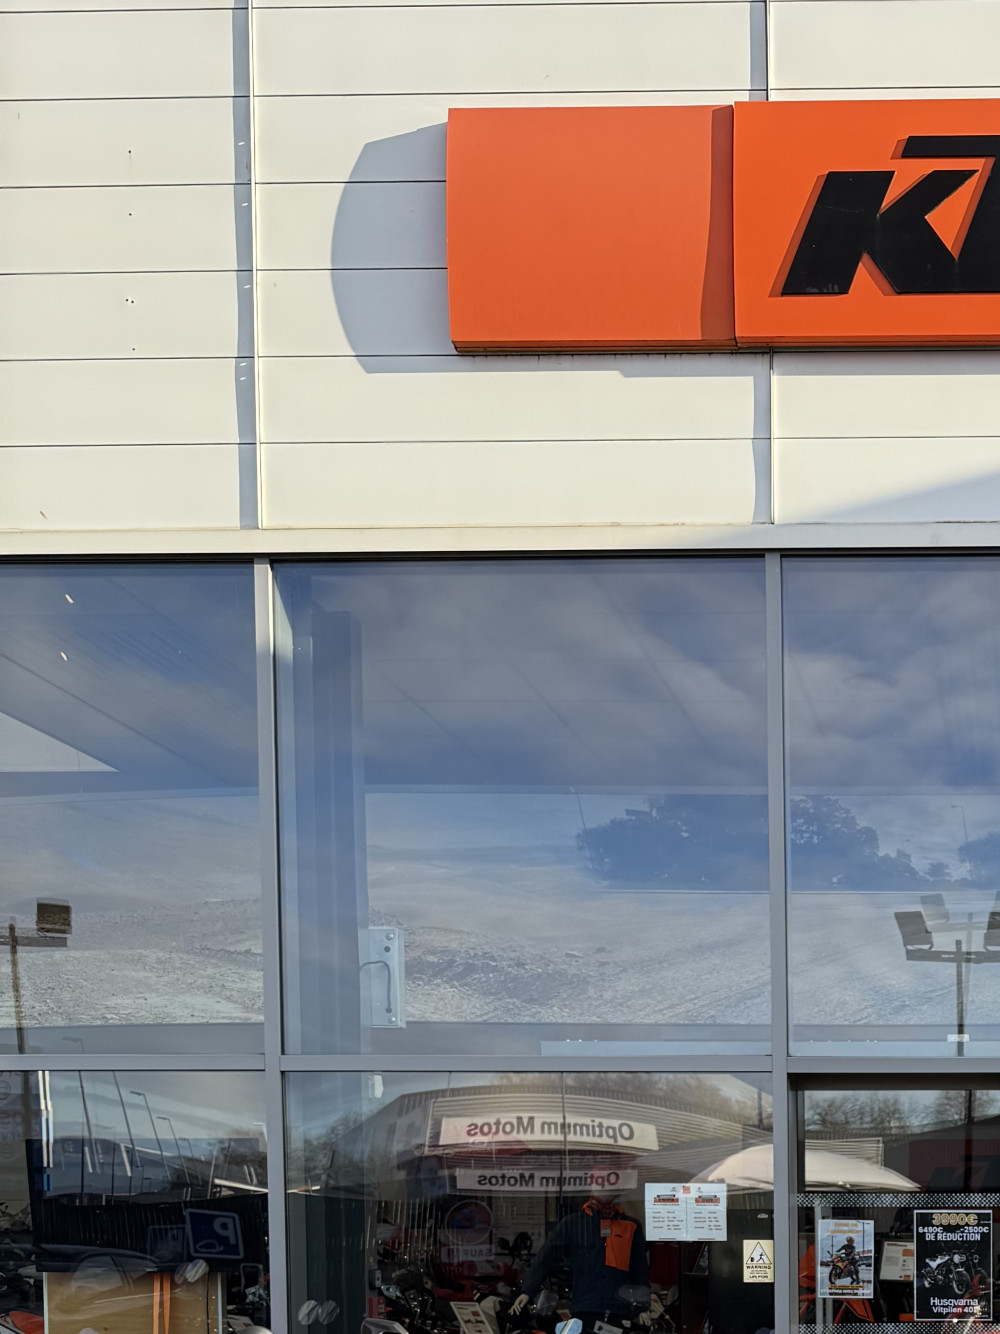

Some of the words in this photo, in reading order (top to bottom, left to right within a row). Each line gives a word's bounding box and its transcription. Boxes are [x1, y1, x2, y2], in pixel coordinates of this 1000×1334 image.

[932, 1213, 978, 1225] 3990€
[937, 1231, 980, 1240] RÉDUCTION
[931, 1297, 978, 1306] Husqvarna
